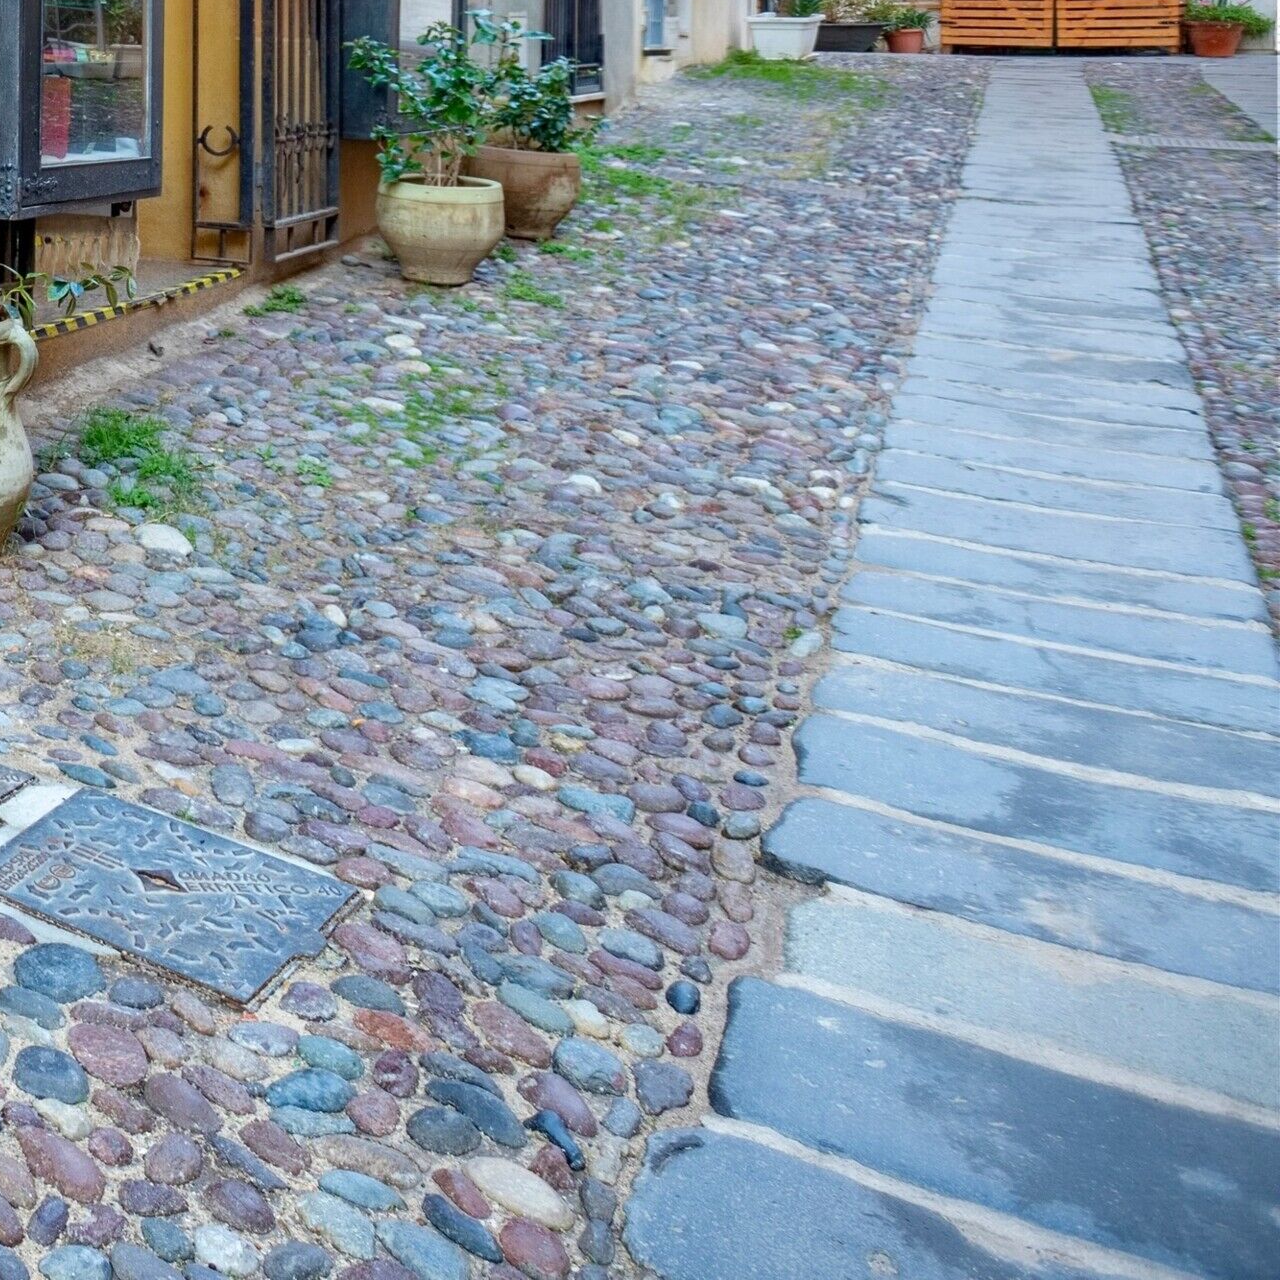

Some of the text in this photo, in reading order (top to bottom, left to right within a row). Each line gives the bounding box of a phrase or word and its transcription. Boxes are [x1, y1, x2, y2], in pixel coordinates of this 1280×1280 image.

[178, 870, 271, 883] QUADRO
[185, 881, 343, 897] ERMETICO 40
